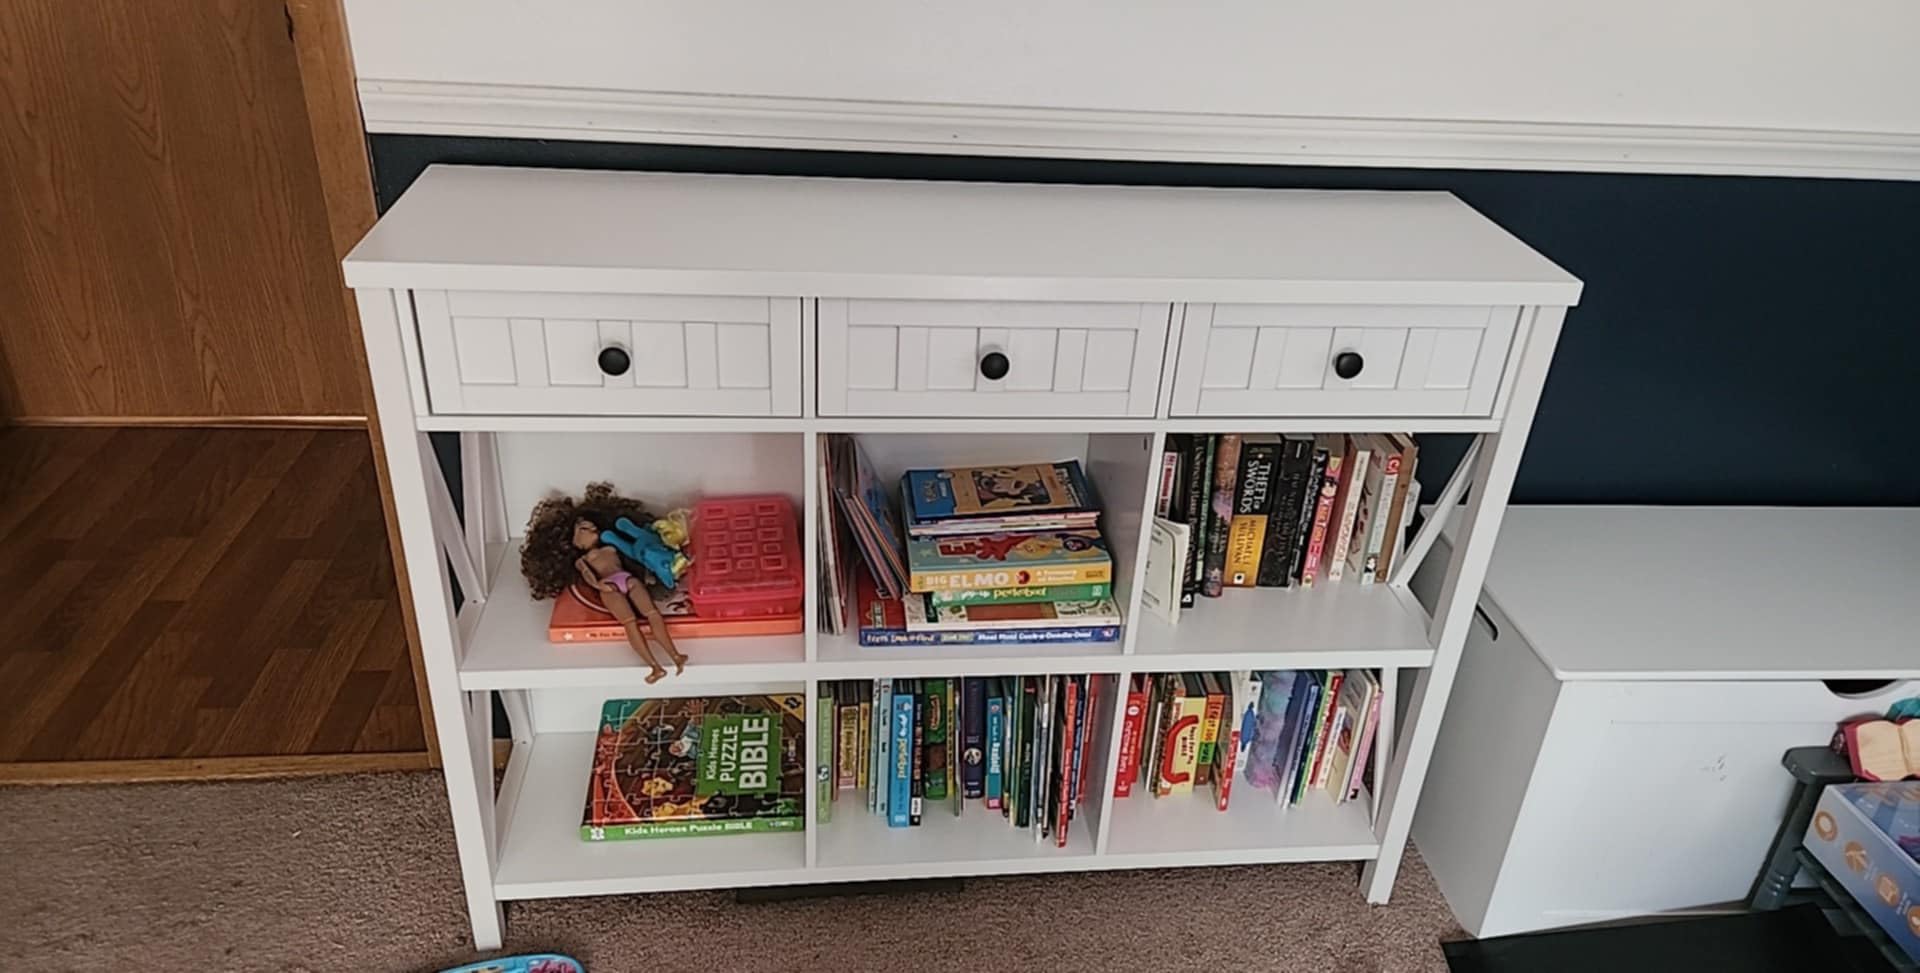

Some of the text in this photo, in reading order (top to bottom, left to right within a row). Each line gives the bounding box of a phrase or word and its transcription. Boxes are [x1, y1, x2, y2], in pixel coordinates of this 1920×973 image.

[1240, 460, 1259, 513] SWORDS
[1254, 462, 1272, 502] THEFT
[1234, 522, 1248, 564] SULLIVAN
[1244, 520, 1257, 559] MICHAEL
[926, 572, 1009, 588] BIG ELMO
[706, 729, 720, 780] Kids Heroes
[719, 725, 738, 782] PUZZLE
[739, 717, 770, 789] BIBLE
[625, 822, 753, 836] Kids Heroes Puzzle BIBLE
